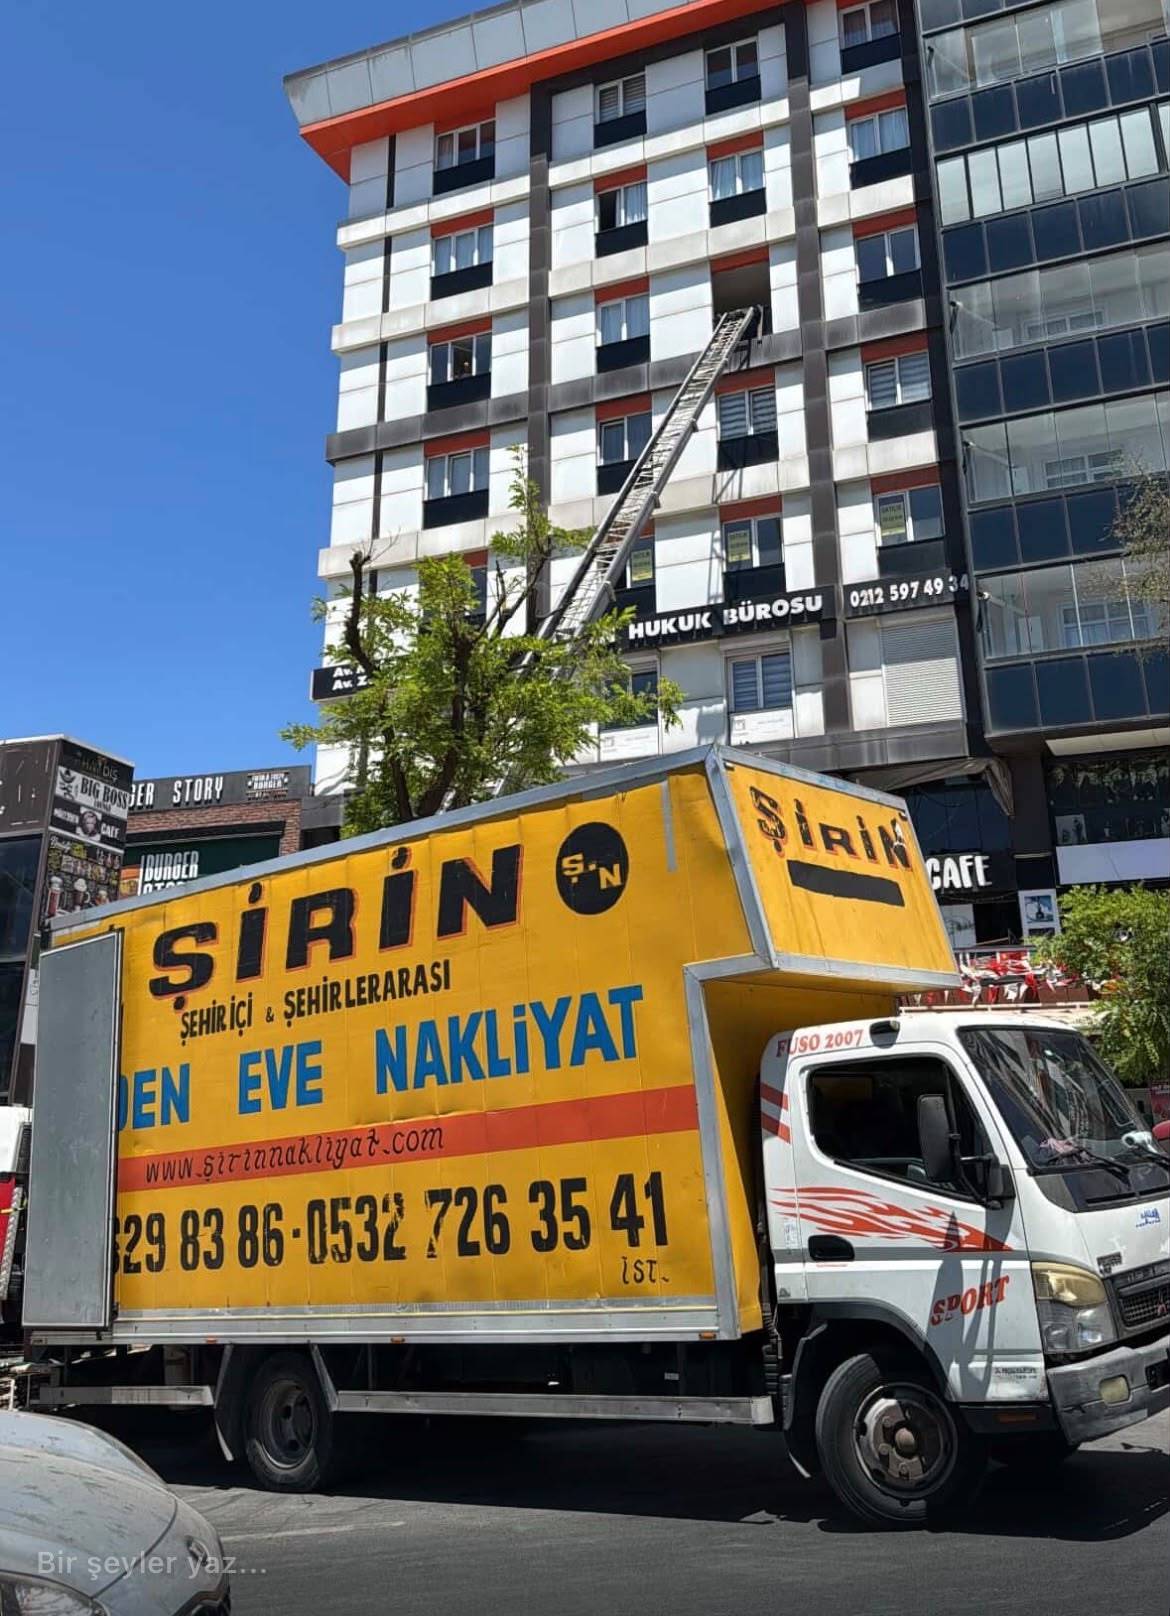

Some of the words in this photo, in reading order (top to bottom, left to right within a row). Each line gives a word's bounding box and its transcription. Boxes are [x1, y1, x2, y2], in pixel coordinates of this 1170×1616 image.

[850, 587, 885, 607] 0212
[889, 581, 920, 601] 597
[923, 577, 944, 596] 49
[948, 573, 969, 592] 34
[628, 611, 712, 640] HUKUK
[723, 595, 822, 625] BÜROSU
[332, 679, 353, 691] Av.
[80, 776, 100, 799] BIG
[103, 786, 129, 809] BOSS
[172, 776, 224, 806] STORY
[750, 786, 913, 873] ŞİRİN
[144, 851, 199, 882] BURGER
[925, 855, 992, 891] CAFE
[149, 843, 524, 1012] ŞİRİN
[266, 1006, 274, 1023] &
[284, 959, 451, 1028] ŞEHİRLERARASI
[238, 1040, 323, 1114] EVE
[375, 984, 643, 1095] NAKLİYAT
[775, 1034, 821, 1058] FUSO
[825, 1029, 864, 1048] 2007
[180, 1208, 225, 1273] 83
[424, 1184, 511, 1259] 726
[528, 1177, 591, 1252] 35
[610, 1171, 668, 1247] 41
[930, 1275, 1010, 1327] SPORT
